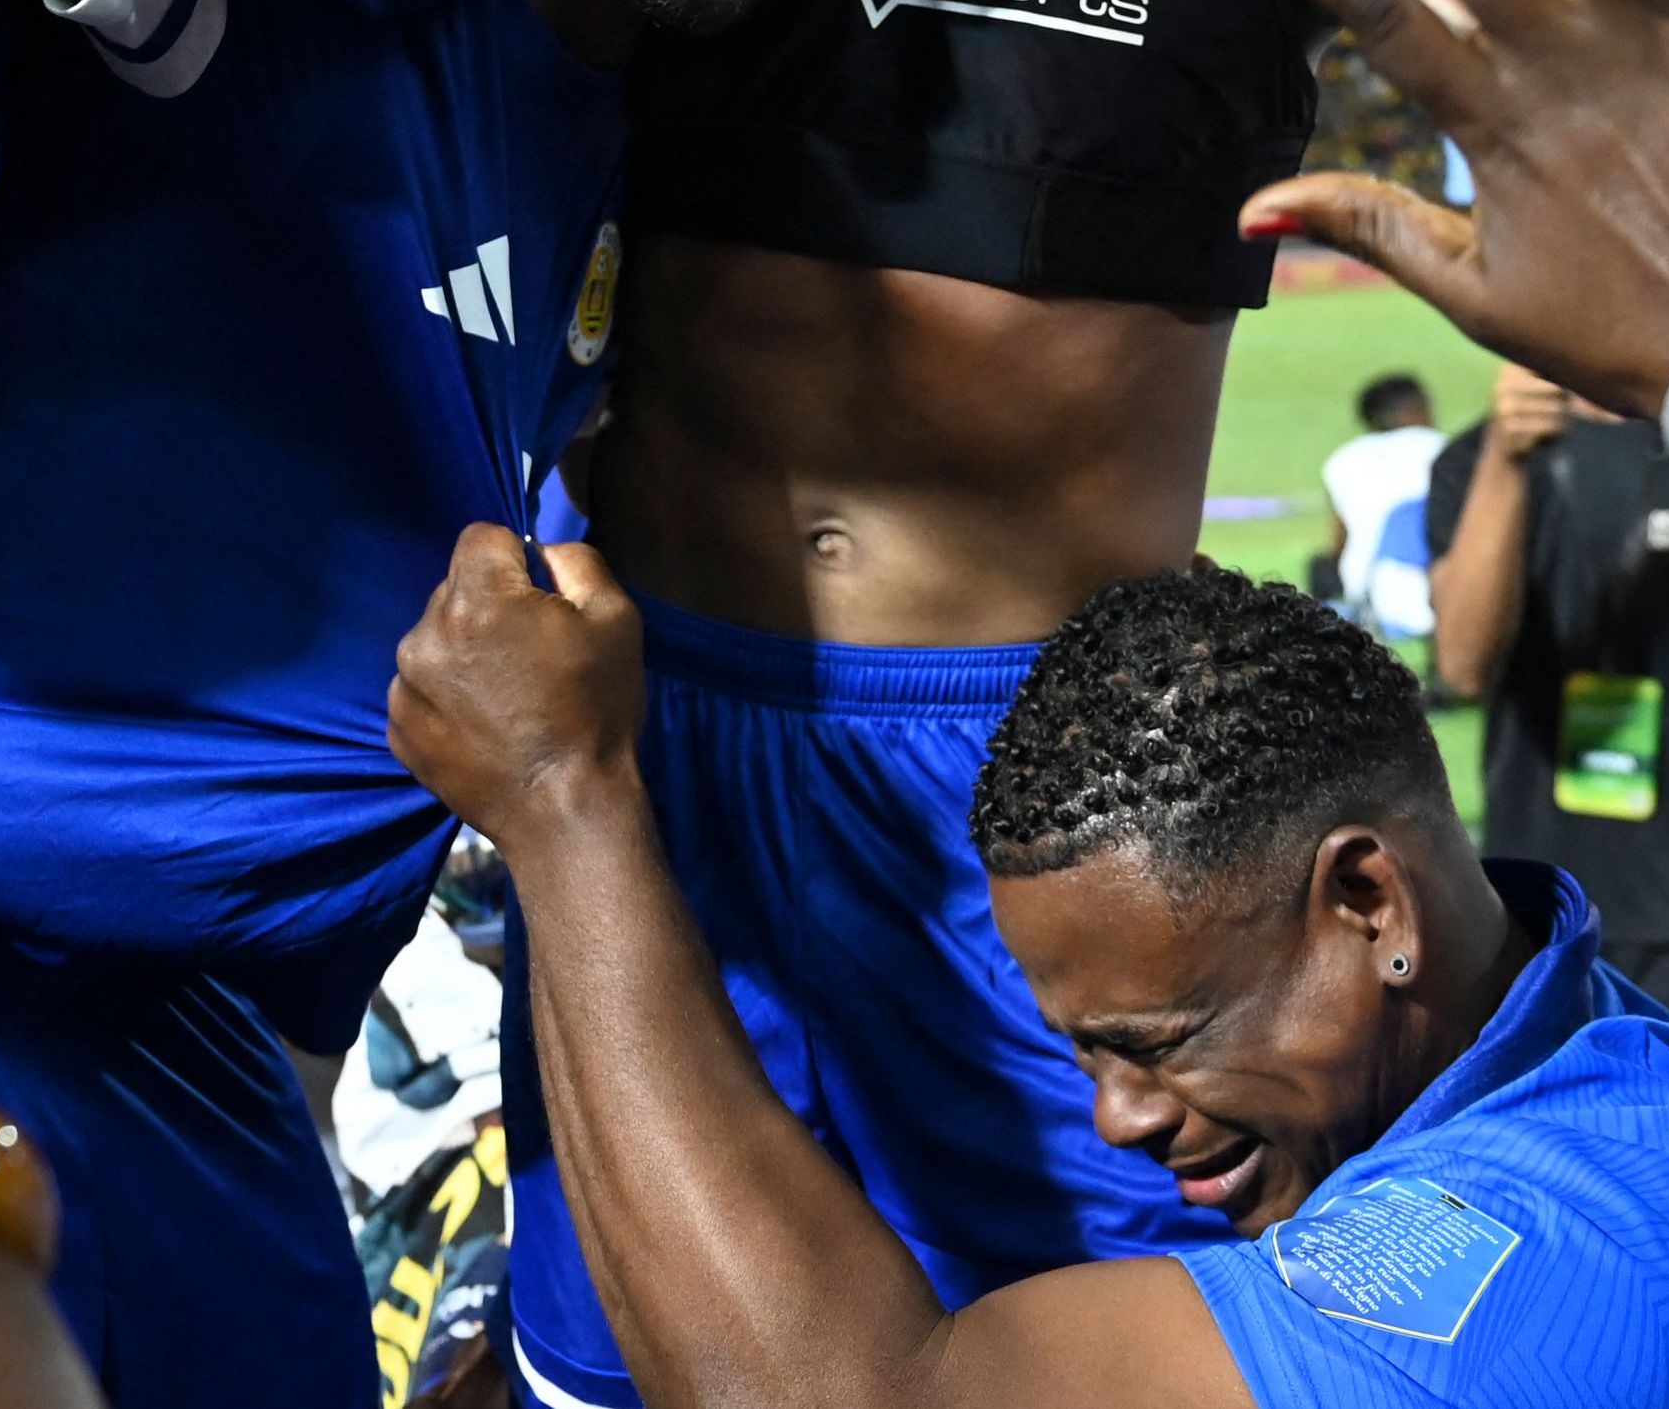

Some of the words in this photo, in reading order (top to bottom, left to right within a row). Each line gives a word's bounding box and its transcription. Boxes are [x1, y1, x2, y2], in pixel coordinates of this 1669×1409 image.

[1361, 1253, 1377, 1268] nos
[1418, 1243, 1447, 1267] kanta
[1301, 1257, 1320, 1271] yu
[1318, 1270, 1333, 1281] di
[1414, 1262, 1432, 1278] kas
[1335, 1269, 1353, 1286] nos
[1351, 1285, 1380, 1312] digno
[1349, 1269, 1366, 1284] sin
[1361, 1283, 1382, 1302] fin,
[1365, 1267, 1405, 1306] Kreador
